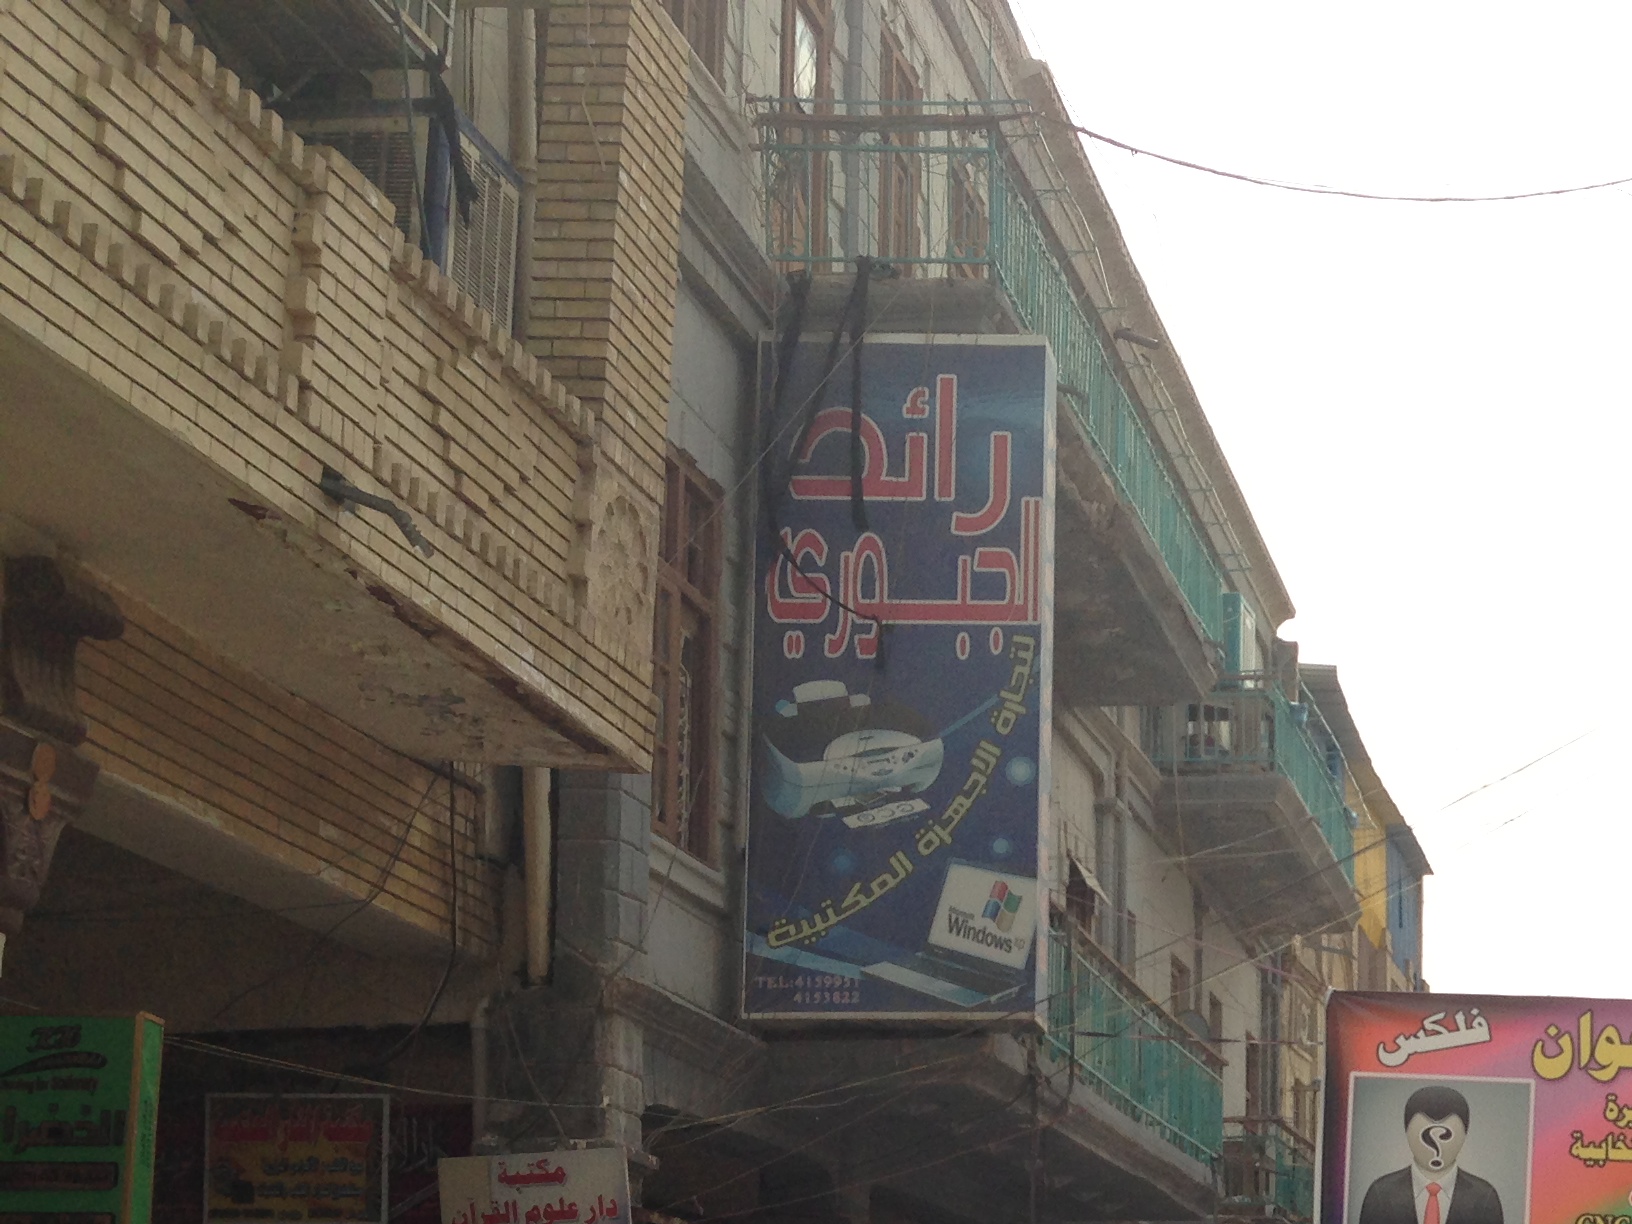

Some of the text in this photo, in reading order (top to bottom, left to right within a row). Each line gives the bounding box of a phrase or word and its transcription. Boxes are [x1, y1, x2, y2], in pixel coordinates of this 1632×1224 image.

[947, 915, 1014, 954] Windows
[1376, 1007, 1492, 1067] فلكس
[497, 1158, 566, 1193] مكتبة
[584, 1193, 618, 1224] دار
